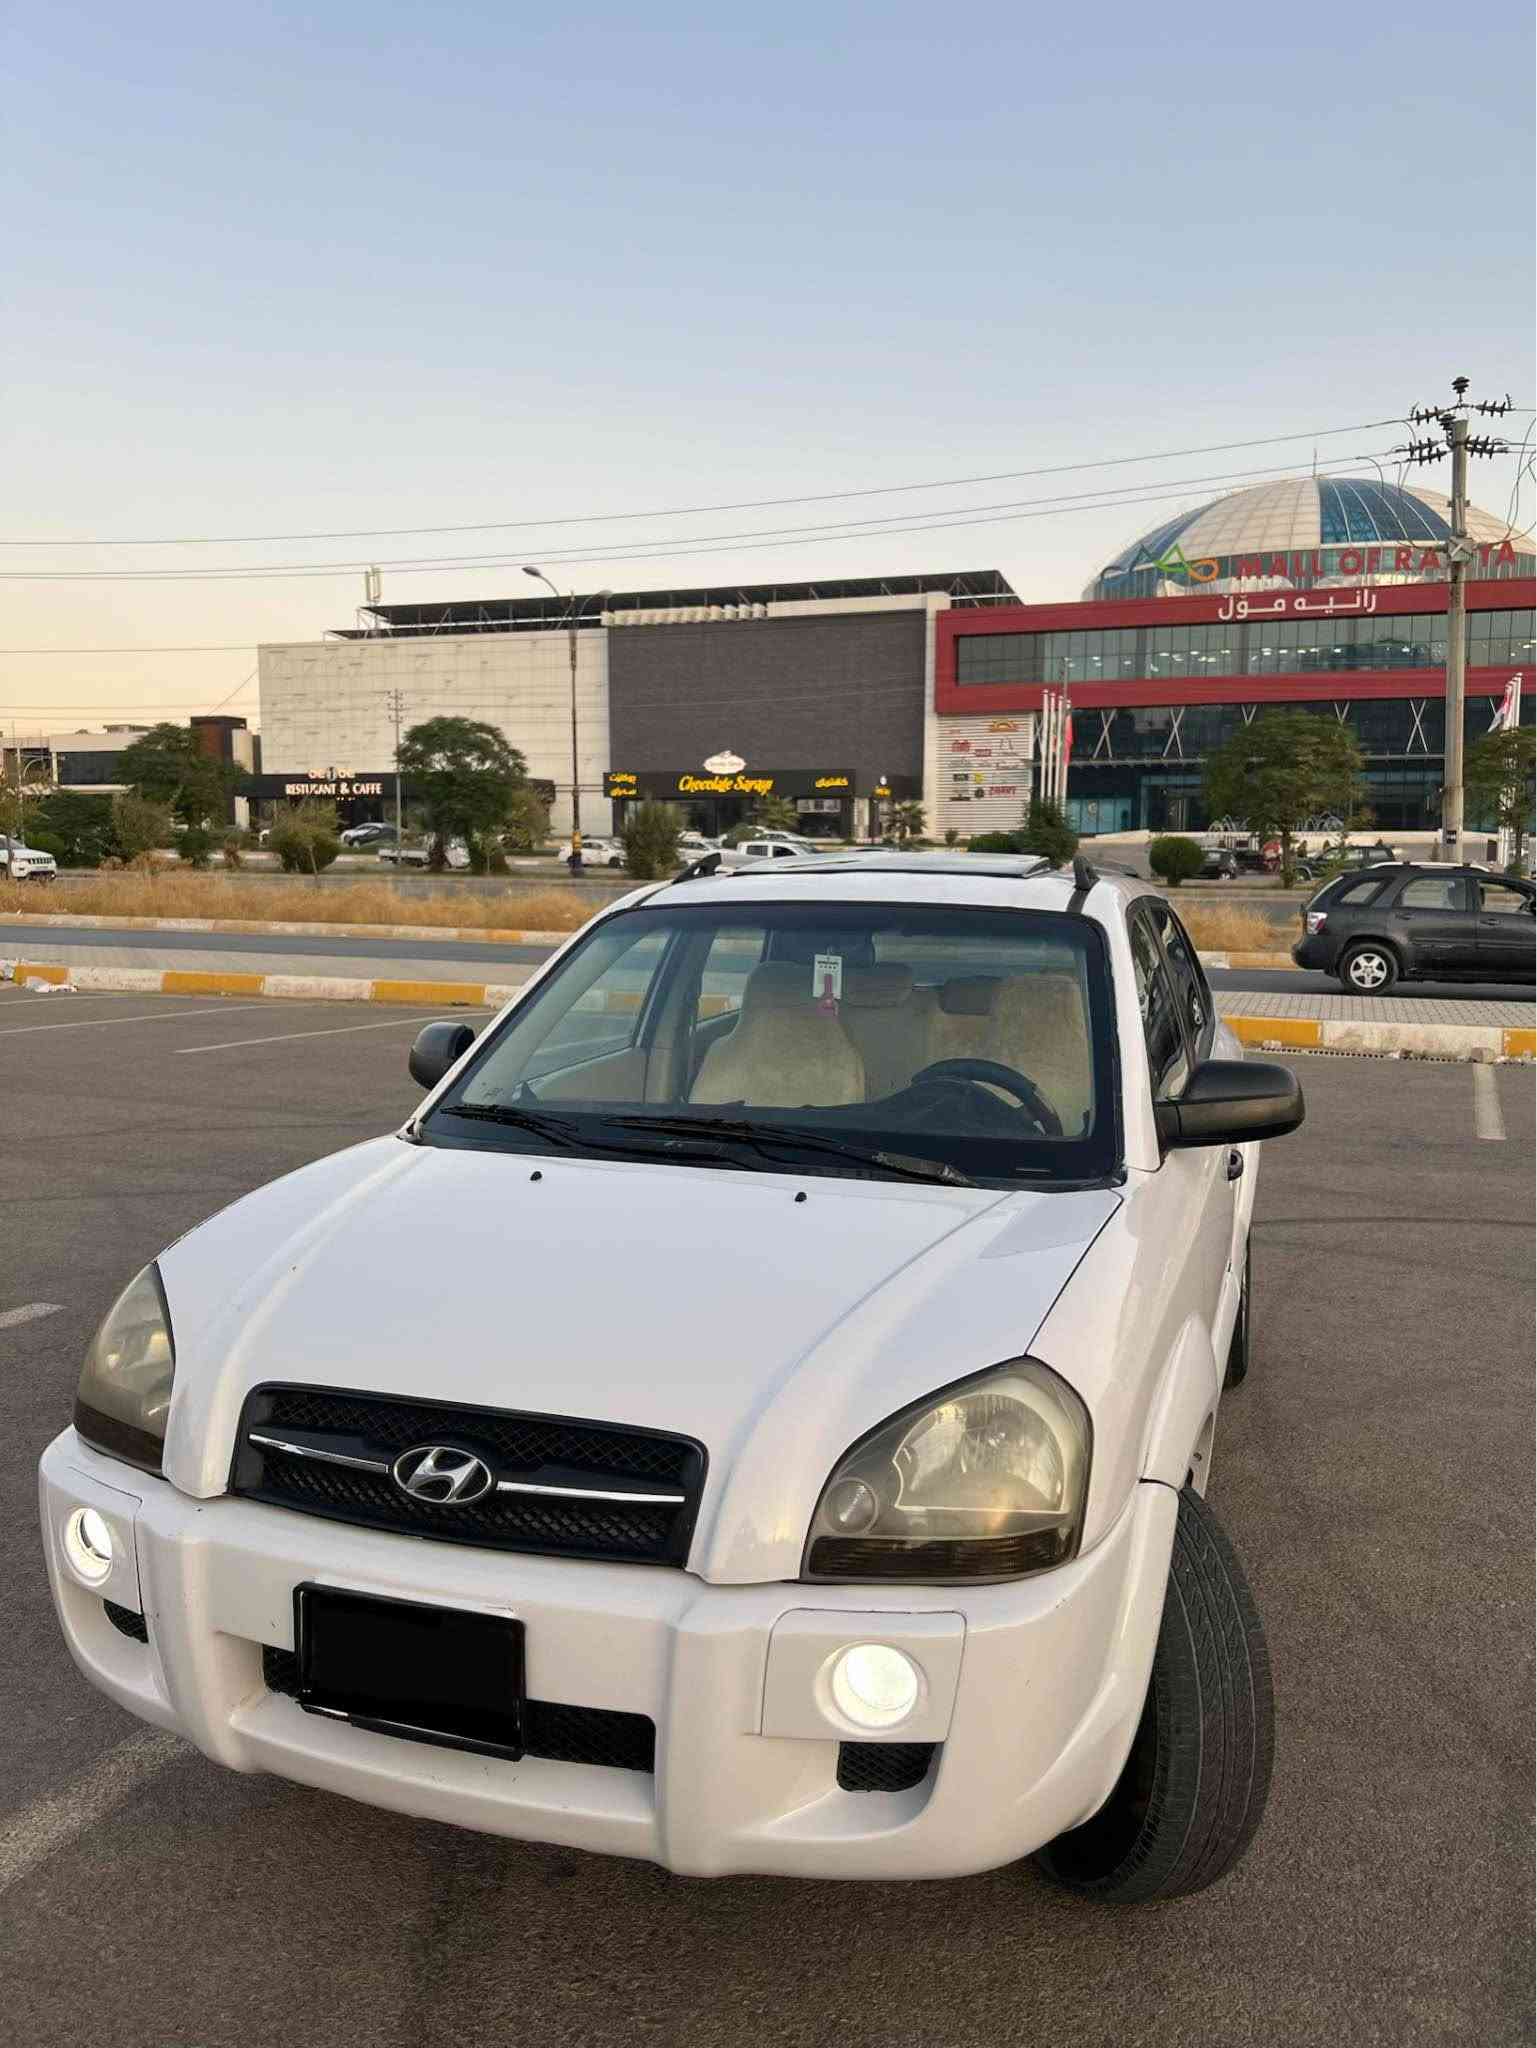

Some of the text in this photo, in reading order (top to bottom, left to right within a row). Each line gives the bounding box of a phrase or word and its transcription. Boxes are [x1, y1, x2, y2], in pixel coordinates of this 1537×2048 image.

[1237, 551, 1324, 578] MALL
[1340, 549, 1381, 576] OF
[340, 782, 350, 794] &
[679, 775, 734, 793] Chocolate
